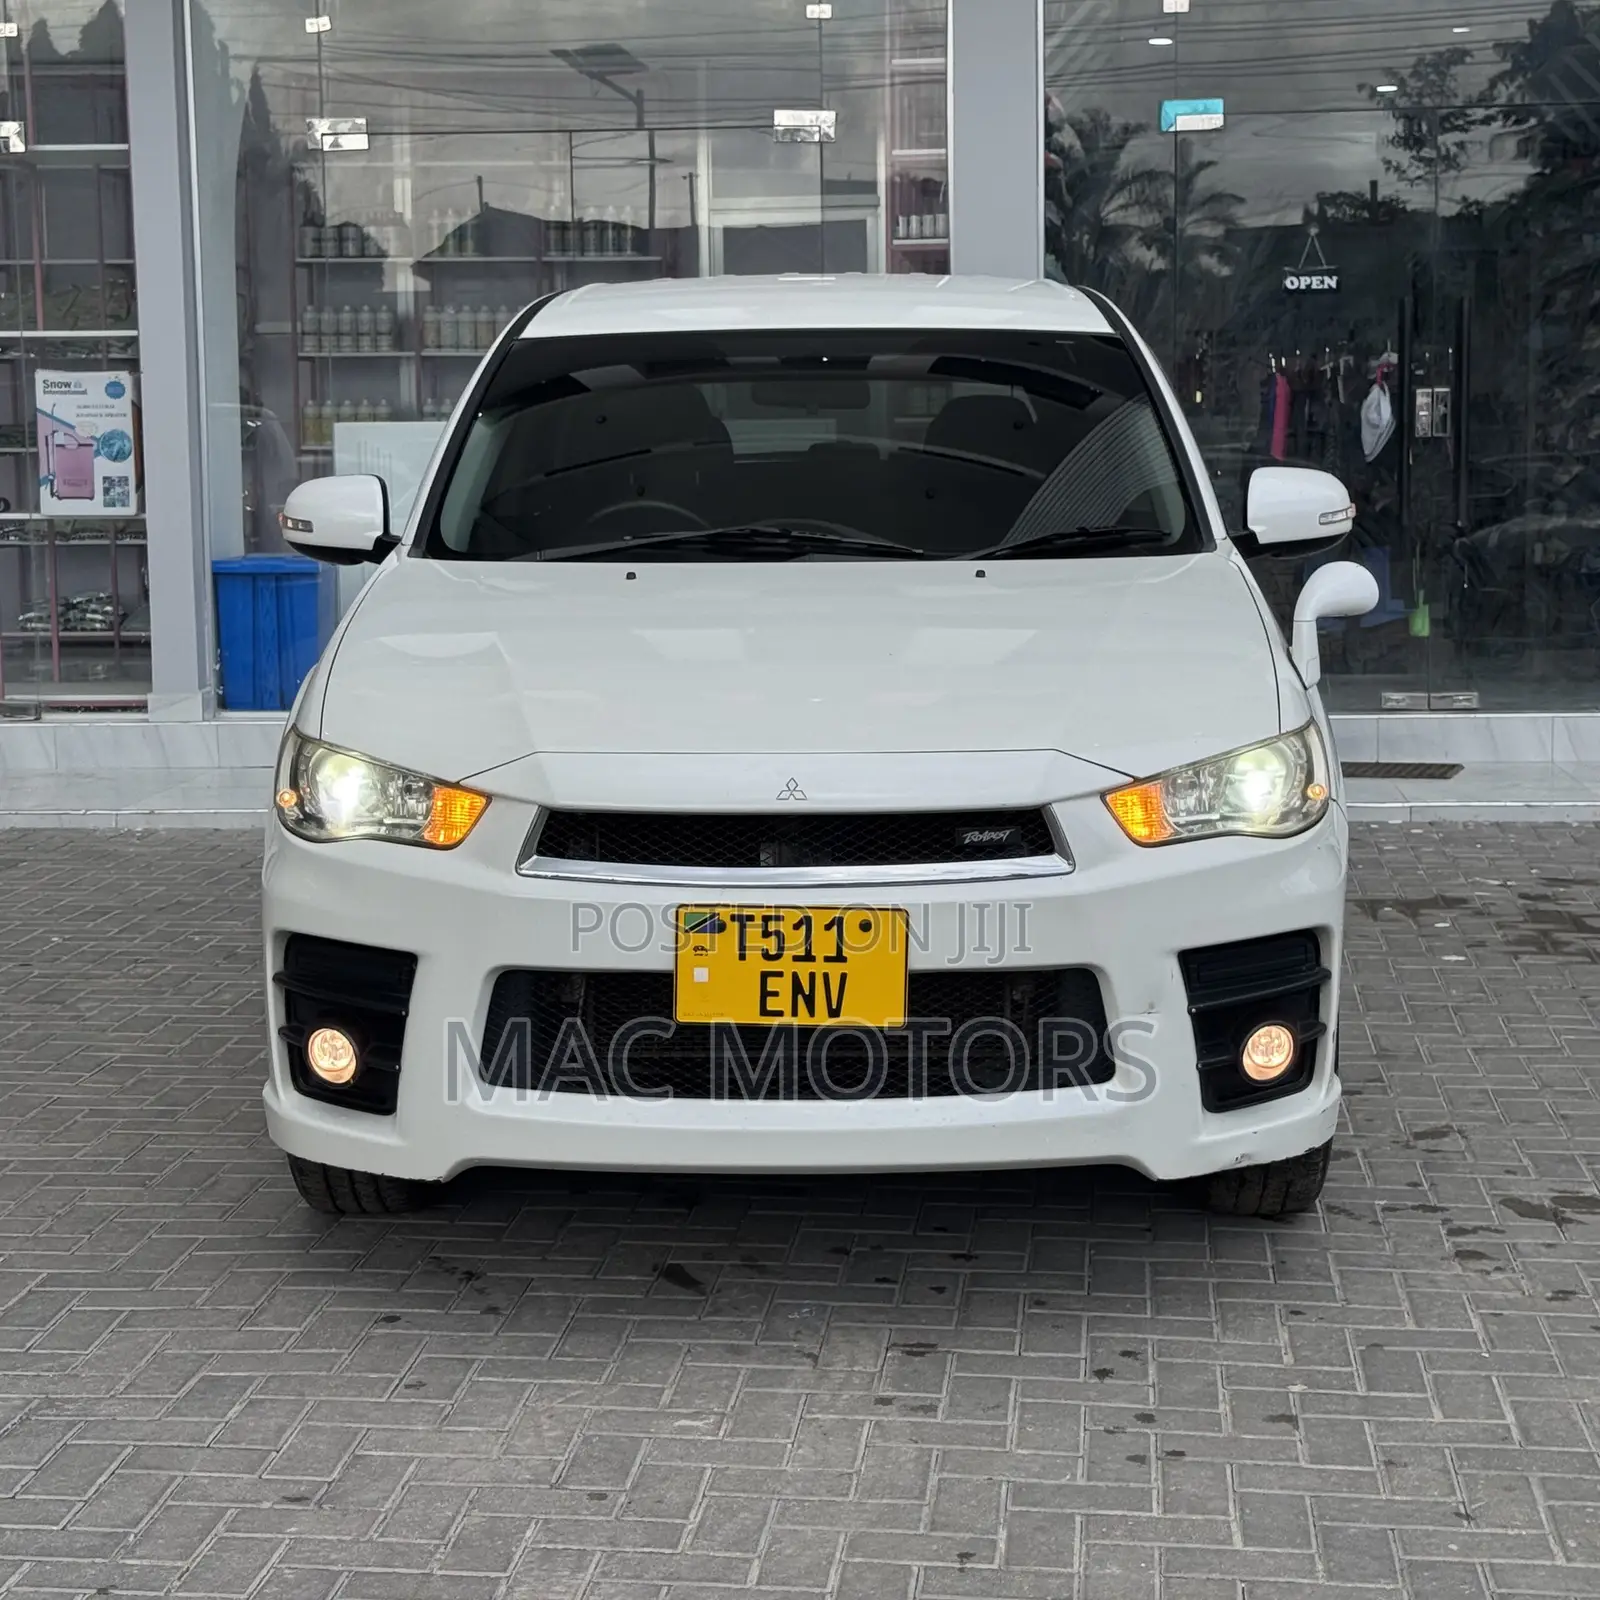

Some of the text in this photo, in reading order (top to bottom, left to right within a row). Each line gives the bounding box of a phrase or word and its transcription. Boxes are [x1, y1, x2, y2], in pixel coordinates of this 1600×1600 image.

[1284, 275, 1339, 290] OPEN
[42, 379, 72, 389] Snow
[729, 912, 848, 964] T511
[759, 969, 849, 1019] ENV
